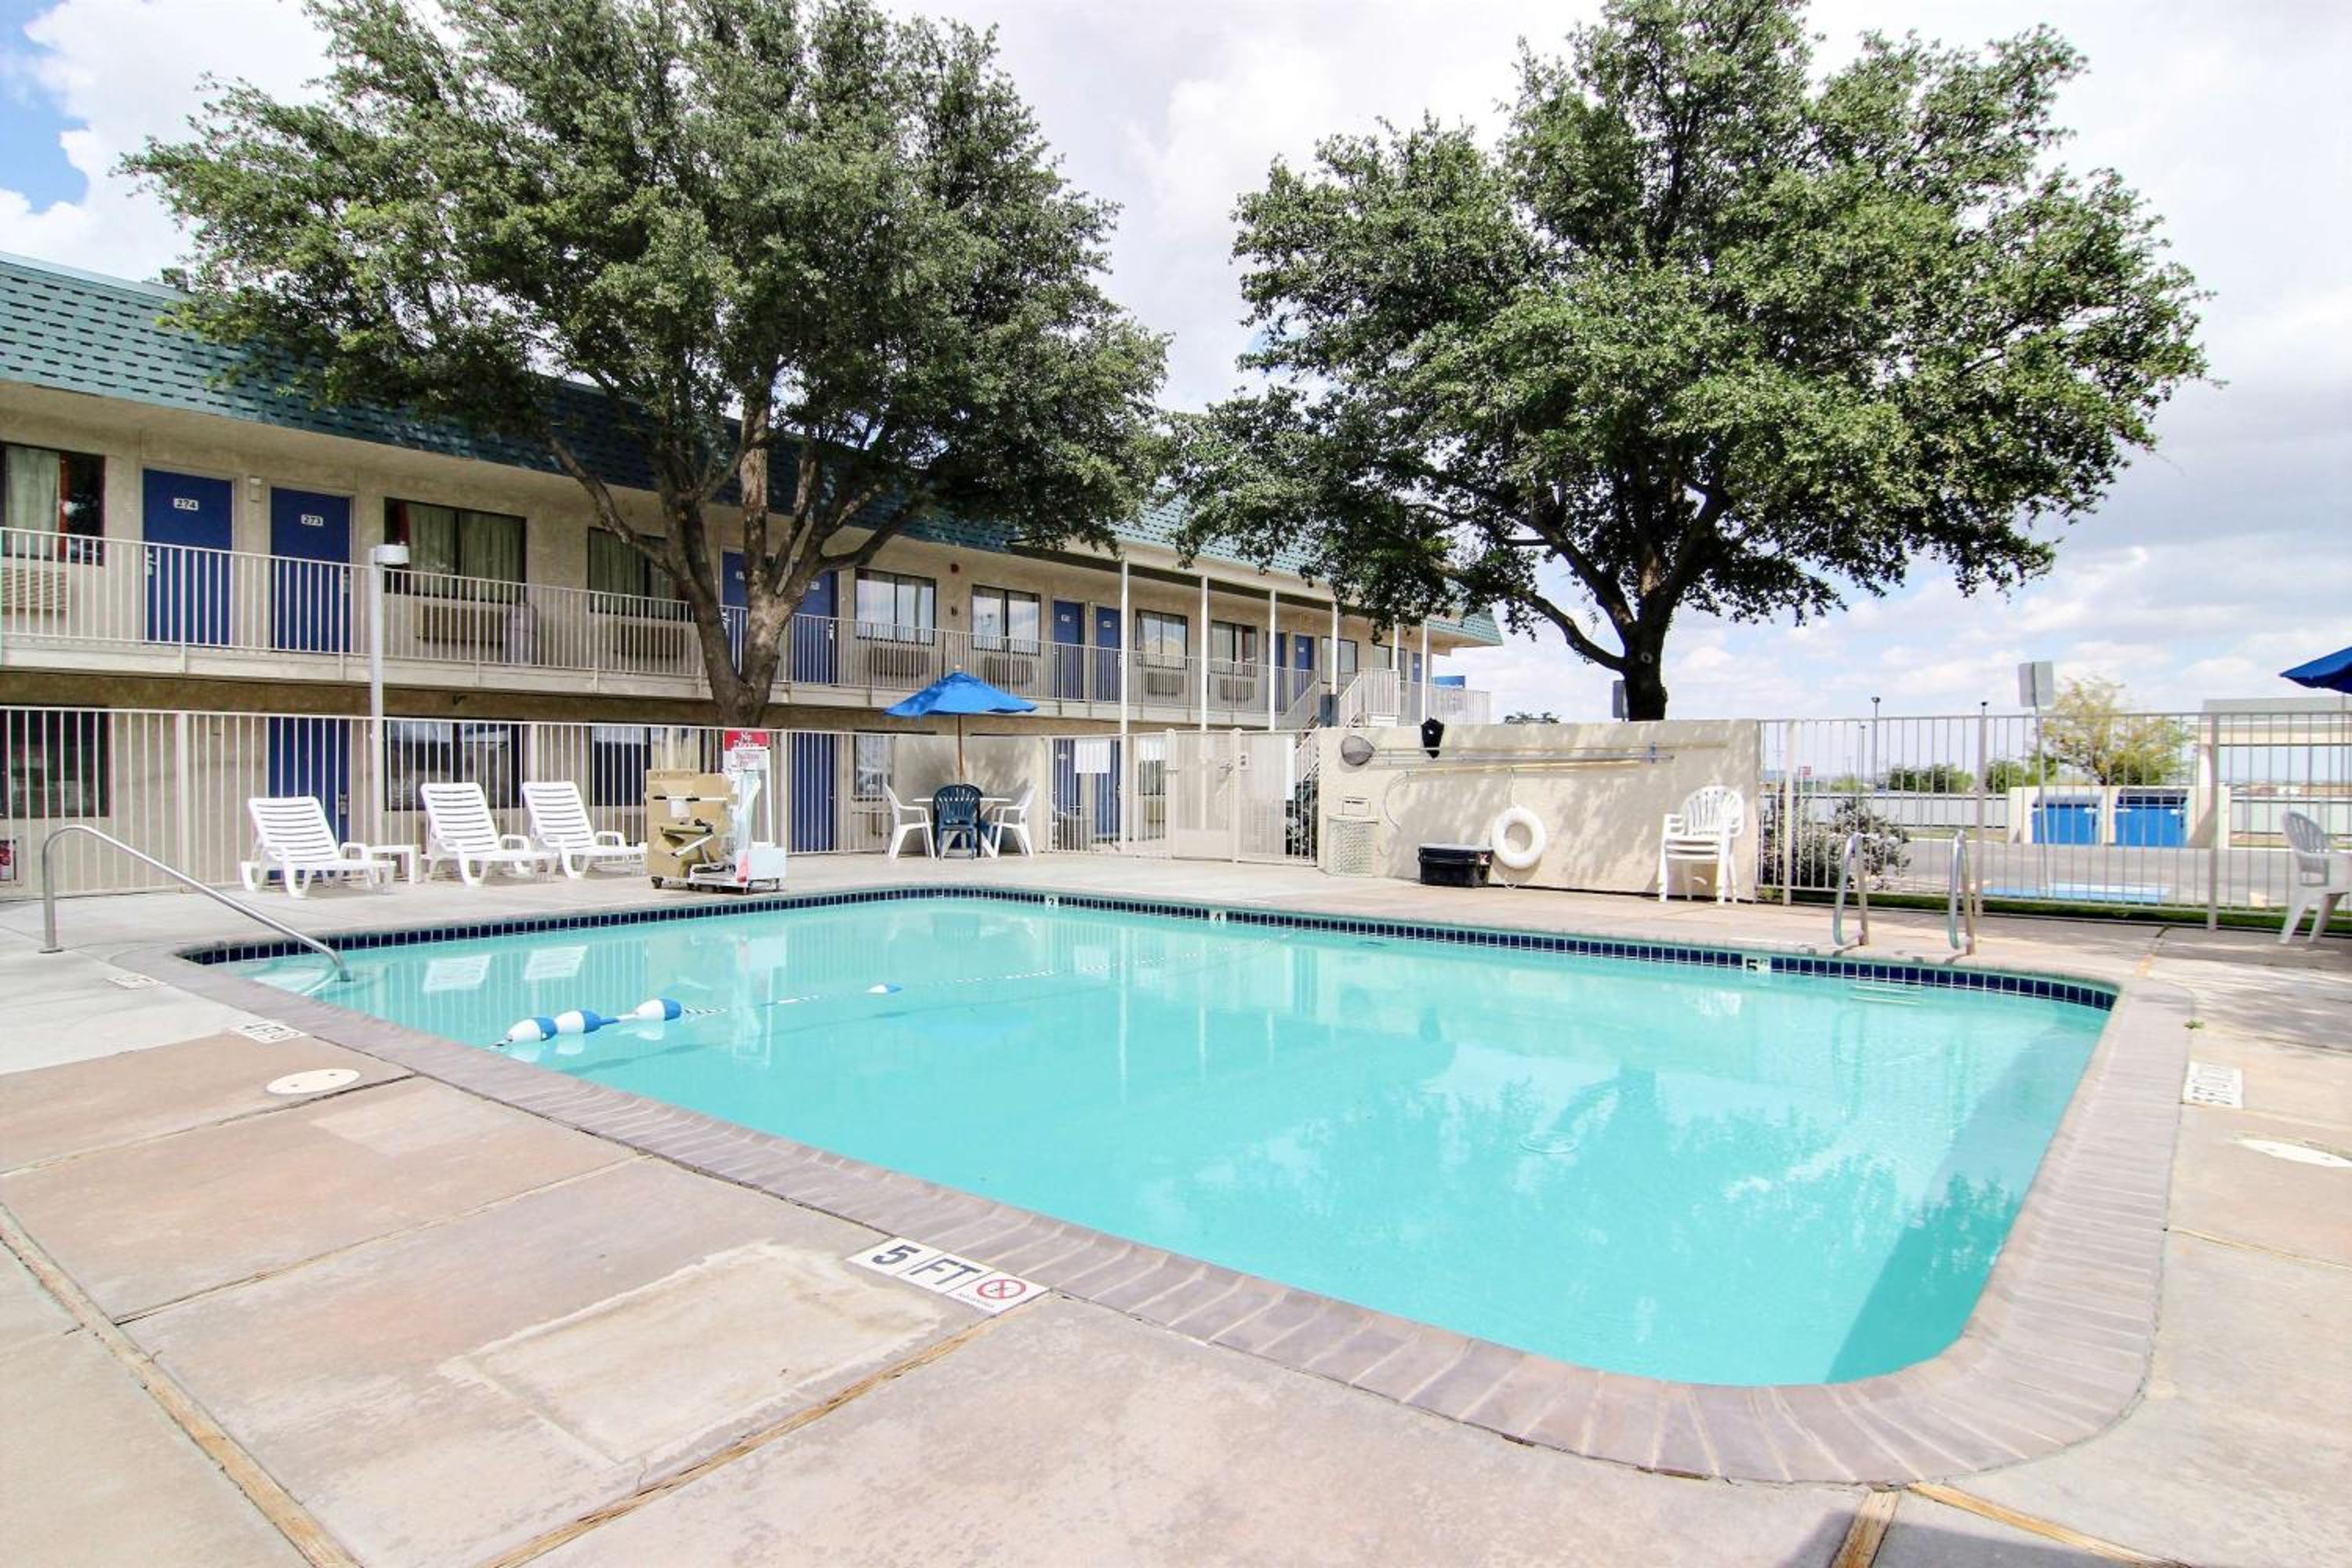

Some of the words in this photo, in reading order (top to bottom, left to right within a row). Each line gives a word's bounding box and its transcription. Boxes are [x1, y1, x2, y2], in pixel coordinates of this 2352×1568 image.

[1746, 958, 1758, 971] 5
[872, 1245, 921, 1265] 5
[909, 1258, 982, 1285] FT
